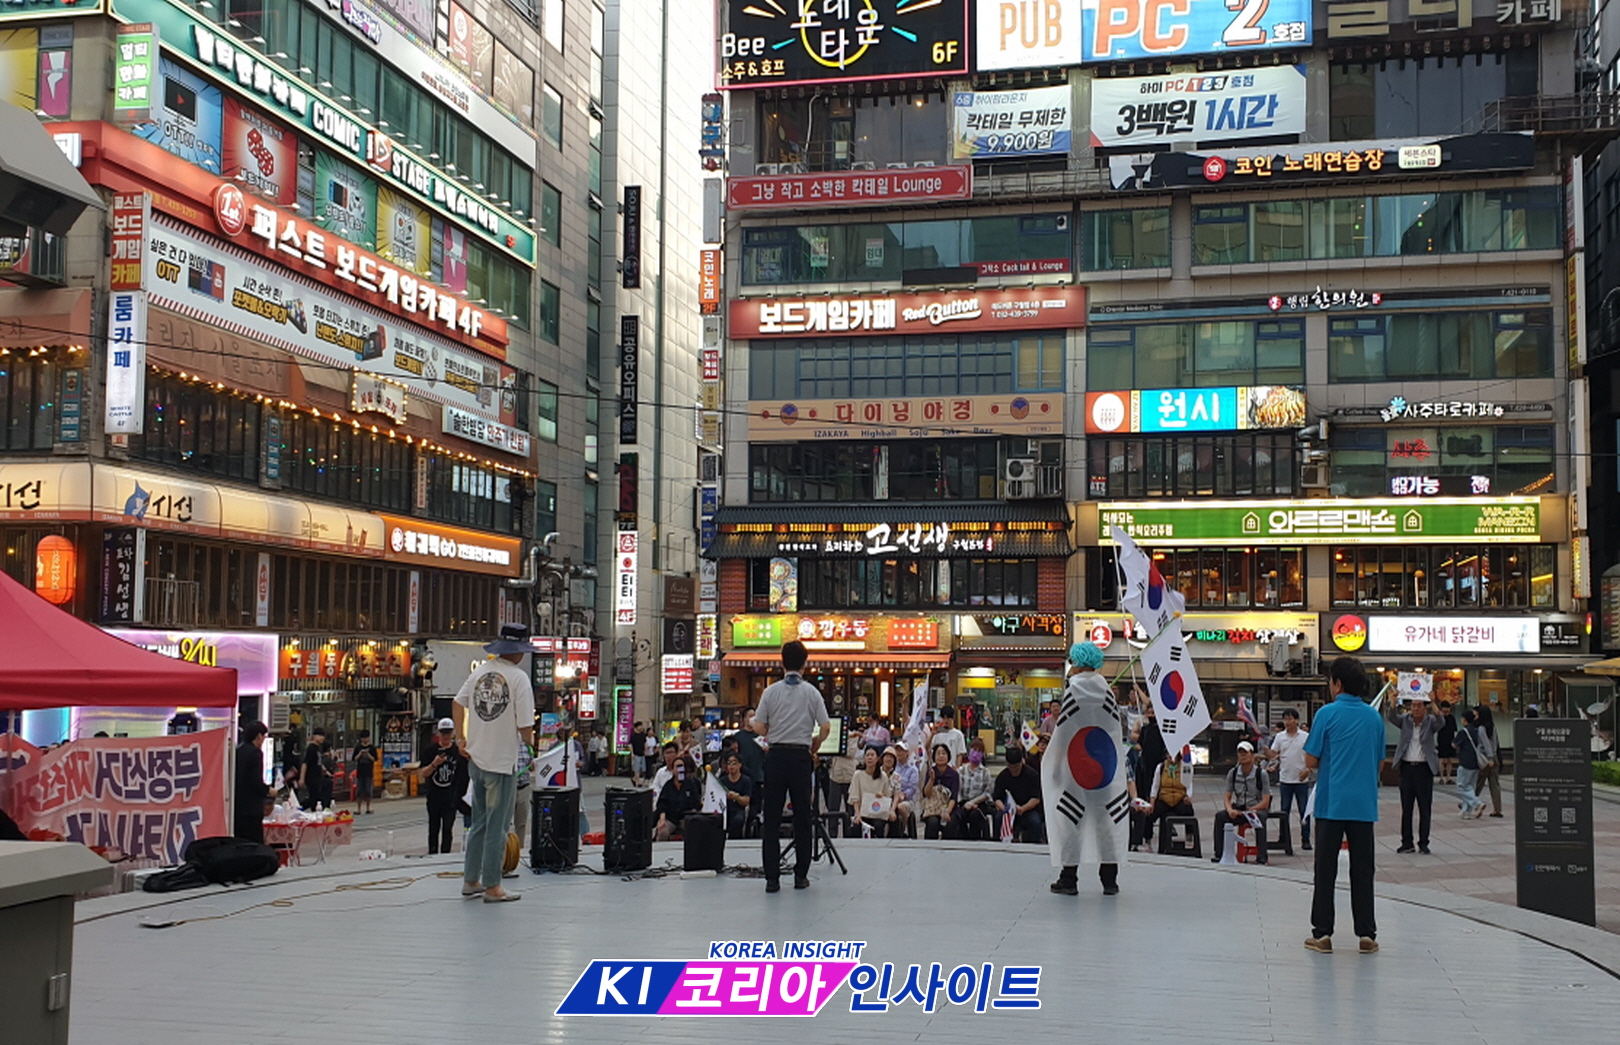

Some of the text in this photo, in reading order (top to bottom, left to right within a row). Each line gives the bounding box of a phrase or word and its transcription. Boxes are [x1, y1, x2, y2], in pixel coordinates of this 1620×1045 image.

[1094, 0, 1188, 56] PC
[1272, 22, 1306, 41] 호점
[721, 33, 765, 57] Bee
[932, 41, 958, 64] 6F
[721, 59, 786, 80] 소주&호프
[1141, 83, 1162, 93] 하이
[1165, 80, 1183, 92] PC
[1231, 75, 1254, 88] 호점
[967, 107, 1066, 130] 칵테일 무제한
[1117, 94, 1279, 136] 3백원 1시간
[313, 101, 360, 152] COMIC
[391, 150, 430, 196] STAGE
[986, 130, 1055, 152] 9,900원
[1233, 149, 1384, 176] 코인 노래연습장
[752, 175, 942, 200] 그냥 작고 소박한 칵테일 Lounge
[114, 214, 142, 235] 보드
[113, 239, 141, 259] 게임
[179, 248, 188, 263] 다
[112, 264, 140, 284] 카페
[157, 259, 181, 284] OTT
[252, 204, 327, 269] 퍼스트
[335, 245, 457, 331] 보드게임카페
[459, 306, 483, 337] 4F
[1311, 285, 1369, 309] 한의원
[703, 304, 717, 314] 2F
[759, 299, 981, 334] 보드게임카페 Red Button
[112, 296, 134, 368] 룸카페
[623, 337, 637, 418] 공유오피스
[836, 400, 971, 422] 다이닝 야경
[1157, 391, 1221, 428] 원시
[1403, 402, 1493, 418] 사주타로카페
[814, 430, 849, 438] IZAKAYA
[861, 429, 897, 437] Highball
[619, 522, 635, 530] 7F
[1268, 510, 1397, 533] 와르르맨숀
[866, 522, 950, 554] 고선생
[618, 611, 634, 621] 4F
[993, 616, 1062, 634] 야구 사격장
[700, 623, 712, 650] 노래
[818, 619, 869, 638] 깡우동
[1196, 629, 1226, 641] 미나리
[1227, 628, 1254, 643] 김치
[1405, 626, 1495, 643] 유가네 닭갈비
[290, 652, 337, 676] 구월동
